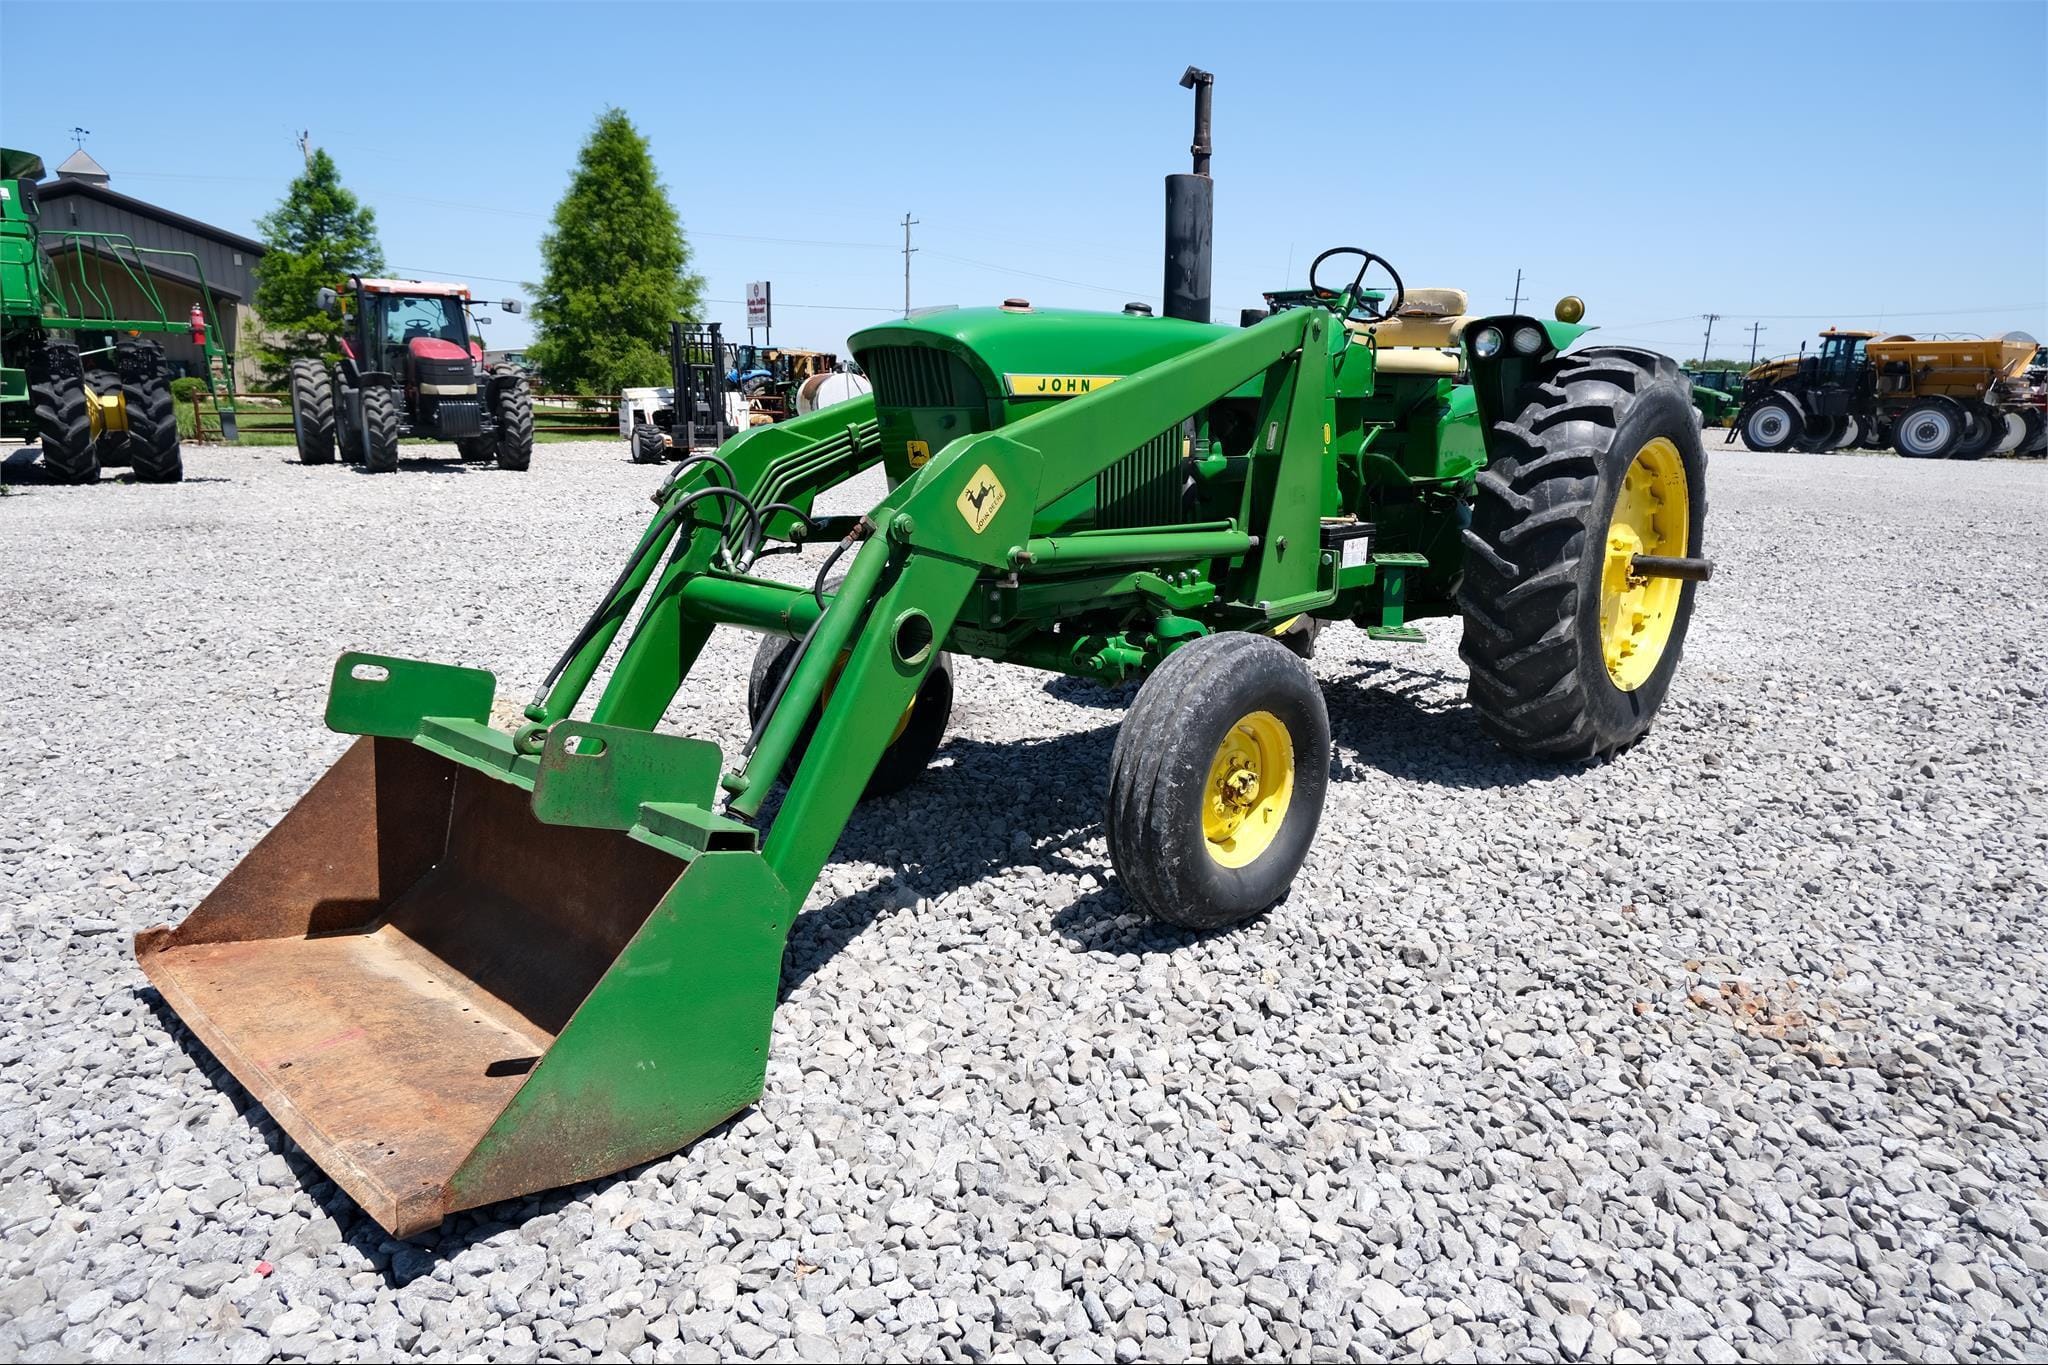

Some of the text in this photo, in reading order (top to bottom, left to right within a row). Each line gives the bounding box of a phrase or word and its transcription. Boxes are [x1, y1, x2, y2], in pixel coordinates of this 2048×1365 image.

[1038, 379, 1090, 392] JOHN
[977, 492, 1004, 531] JOHN DEERE
